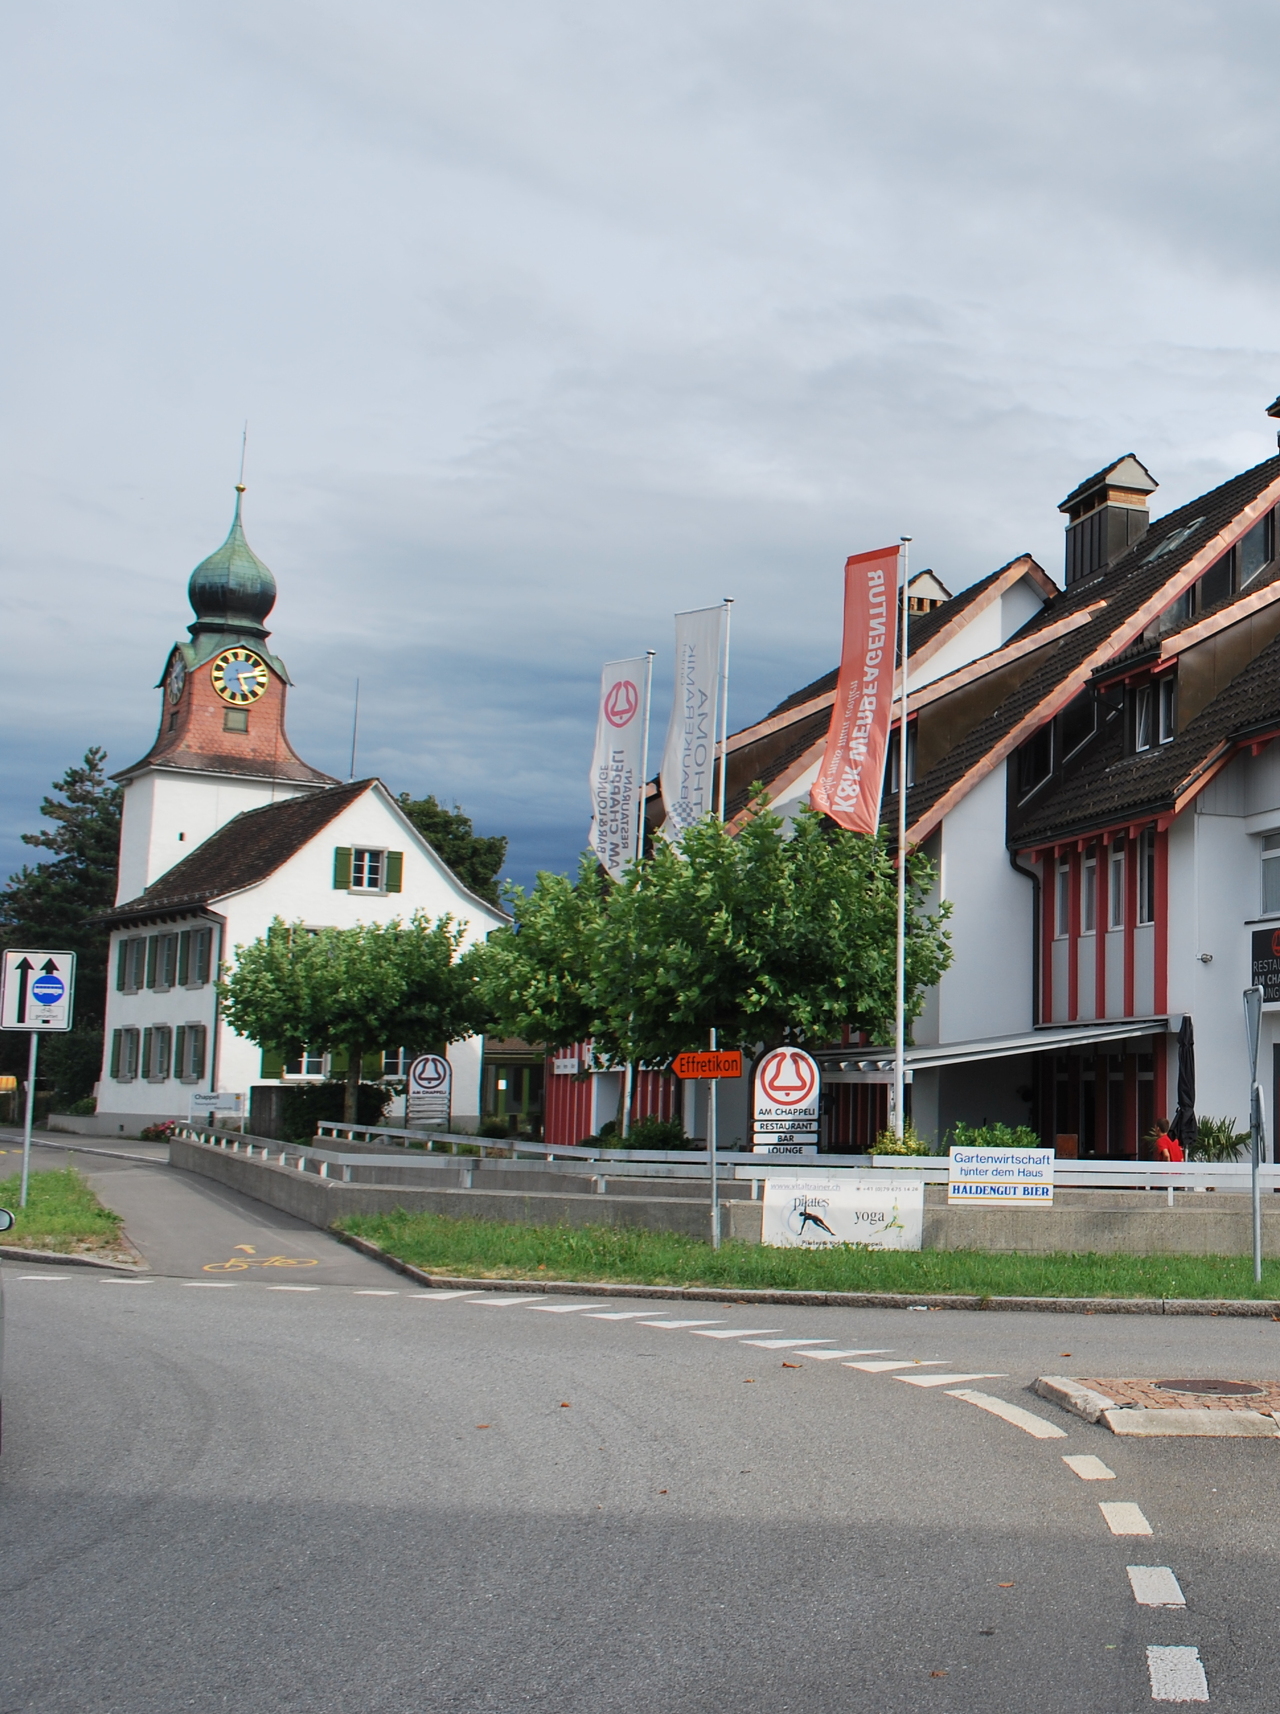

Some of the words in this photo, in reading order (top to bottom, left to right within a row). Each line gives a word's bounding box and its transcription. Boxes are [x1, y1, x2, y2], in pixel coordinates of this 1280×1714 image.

[1253, 975, 1265, 986] AM
[680, 1055, 738, 1073] Effretikon
[758, 1108, 772, 1116] AM
[774, 1108, 816, 1116] CHAPPELI
[760, 1122, 813, 1130] RESTAURANT
[767, 1146, 804, 1154] LOUNGE
[954, 1152, 1050, 1165] Gartenwirtschaft
[960, 1167, 989, 1177] hinter
[991, 1168, 1014, 1177] dem
[1017, 1168, 1044, 1177] Haus
[952, 1185, 1018, 1195] HALDENGUT
[1022, 1186, 1049, 1196] BIER
[793, 1194, 830, 1211] pilates
[854, 1211, 885, 1226] yoga
